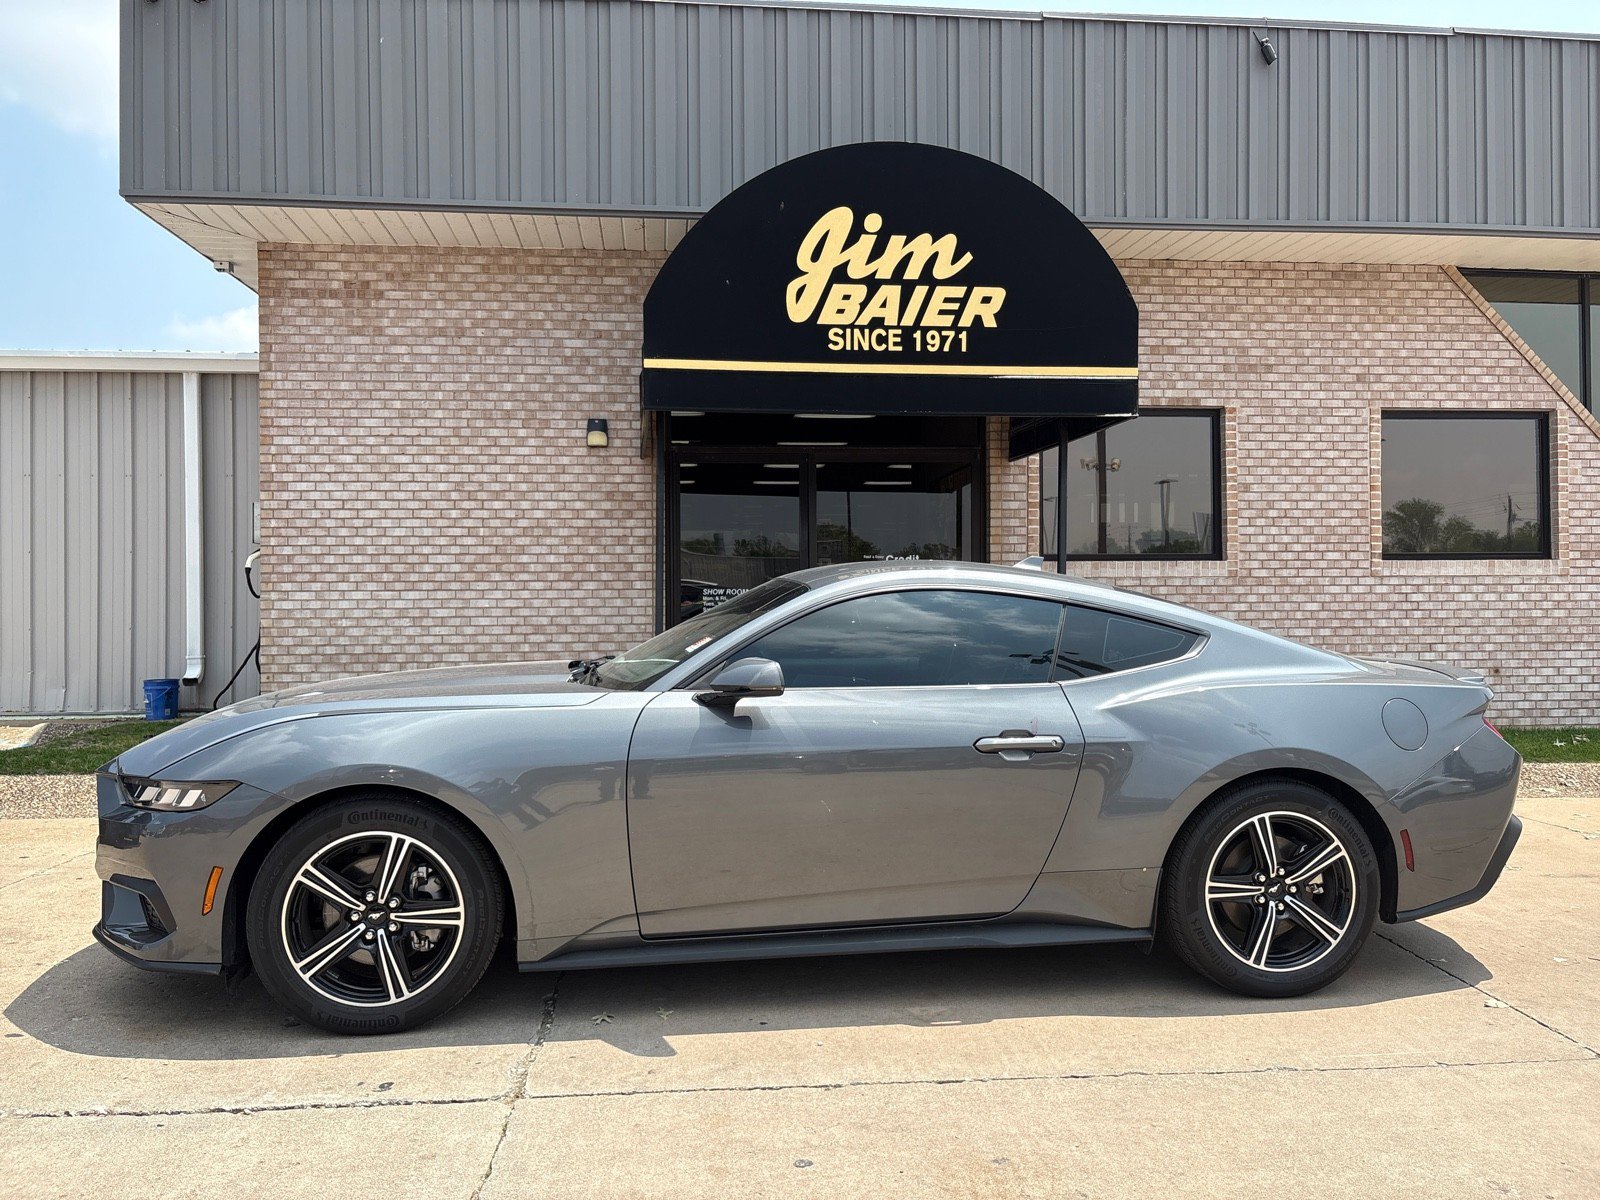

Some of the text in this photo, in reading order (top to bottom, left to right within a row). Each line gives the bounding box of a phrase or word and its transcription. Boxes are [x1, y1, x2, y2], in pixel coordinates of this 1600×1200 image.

[786, 206, 974, 323] Jim
[817, 284, 1007, 328] BAIER
[828, 327, 968, 353] SINCE 1971
[702, 588, 725, 596] SHOW
[347, 808, 419, 827] Continental
[1327, 807, 1370, 858] Continental
